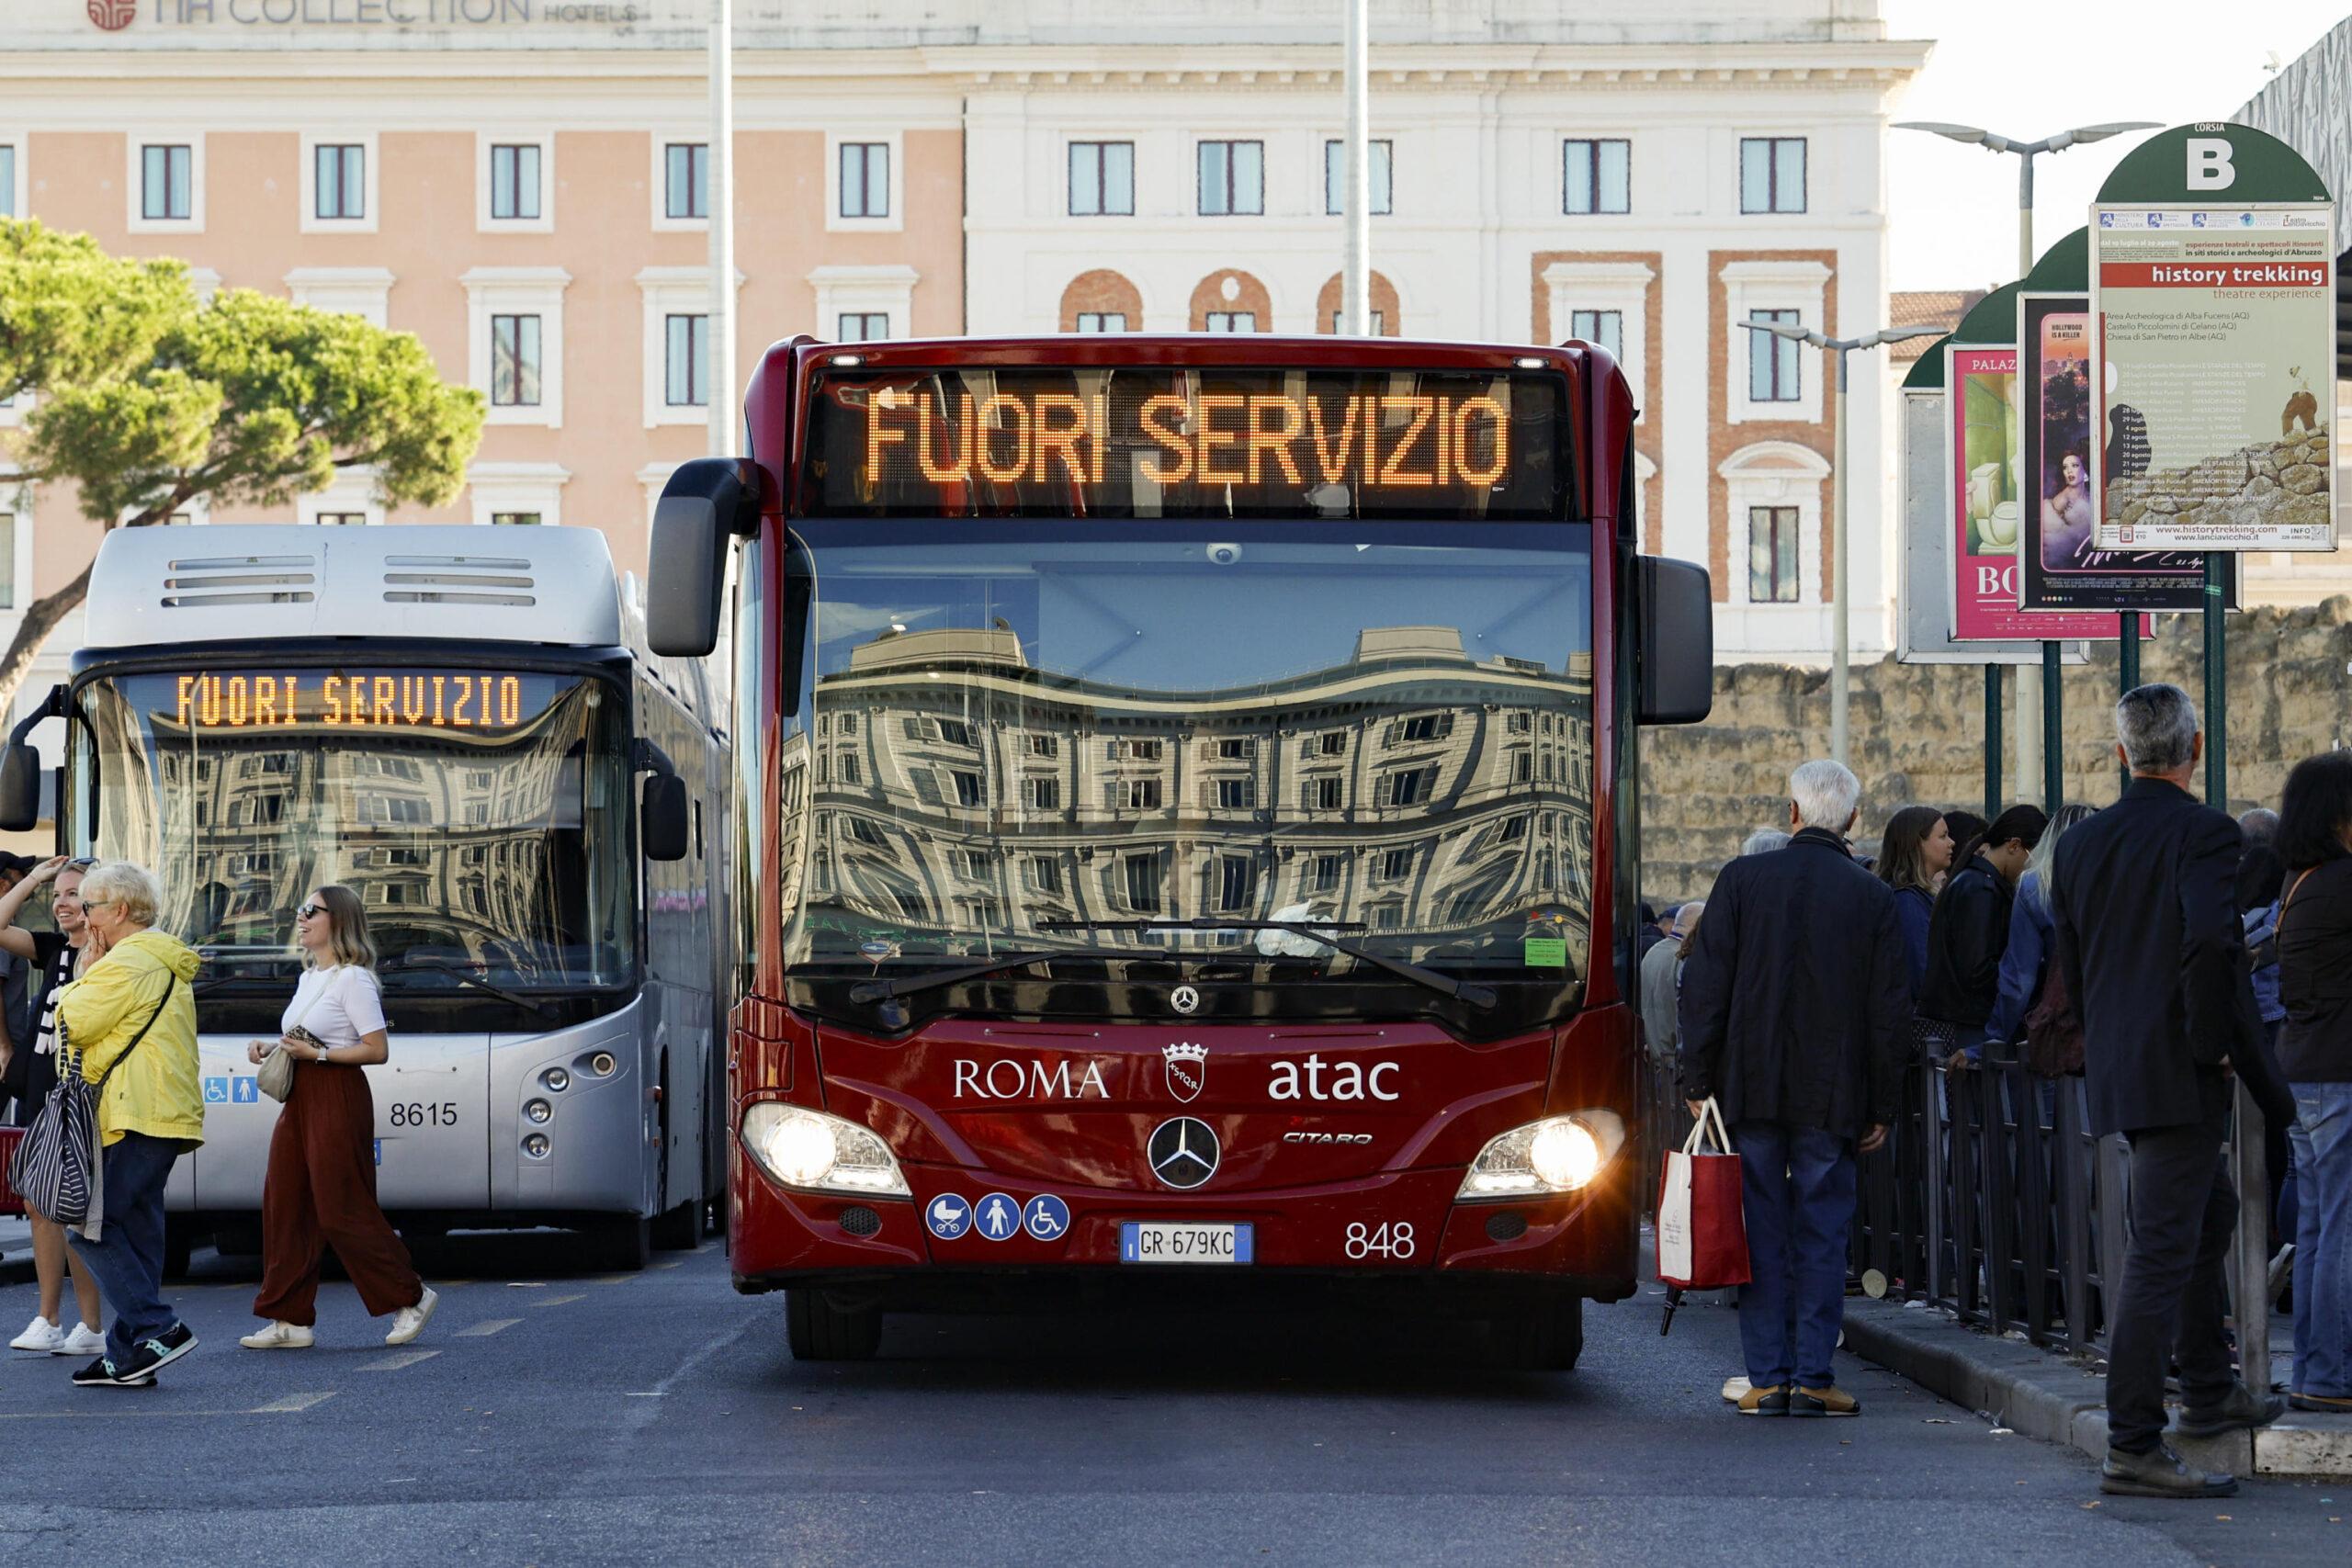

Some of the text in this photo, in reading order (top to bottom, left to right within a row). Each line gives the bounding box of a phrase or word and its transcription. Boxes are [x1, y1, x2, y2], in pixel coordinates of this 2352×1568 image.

[544, 5, 638, 23] HOTELS
[2194, 123, 2225, 132] CORSIA
[2187, 138, 2236, 191] B
[2185, 241, 2223, 249] esperienze
[2256, 241, 2291, 249] spettacoli
[2152, 265, 2323, 286] history trekking
[2213, 288, 2322, 301] theatre experience
[2106, 321, 2236, 331] Castello Piccolomini di Celano (AQ)
[2125, 312, 2175, 321] Archeologica
[2232, 312, 2249, 321] (AQ)
[2106, 333, 2226, 342] Chiesa di San Pietro in Albe (AQ)
[866, 393, 1510, 486] FUORI SERVIZIO
[2155, 525, 2278, 536] www.historytrekking.com
[178, 676, 519, 726] FUORI SERVIZIO
[953, 1059, 1112, 1099] ROMA
[1174, 1067, 1198, 1089] SPQR
[1268, 1054, 1400, 1100] atac
[390, 1102, 458, 1127] 8615
[1283, 1132, 1374, 1145] CITARO
[1345, 1222, 1415, 1259] 848
